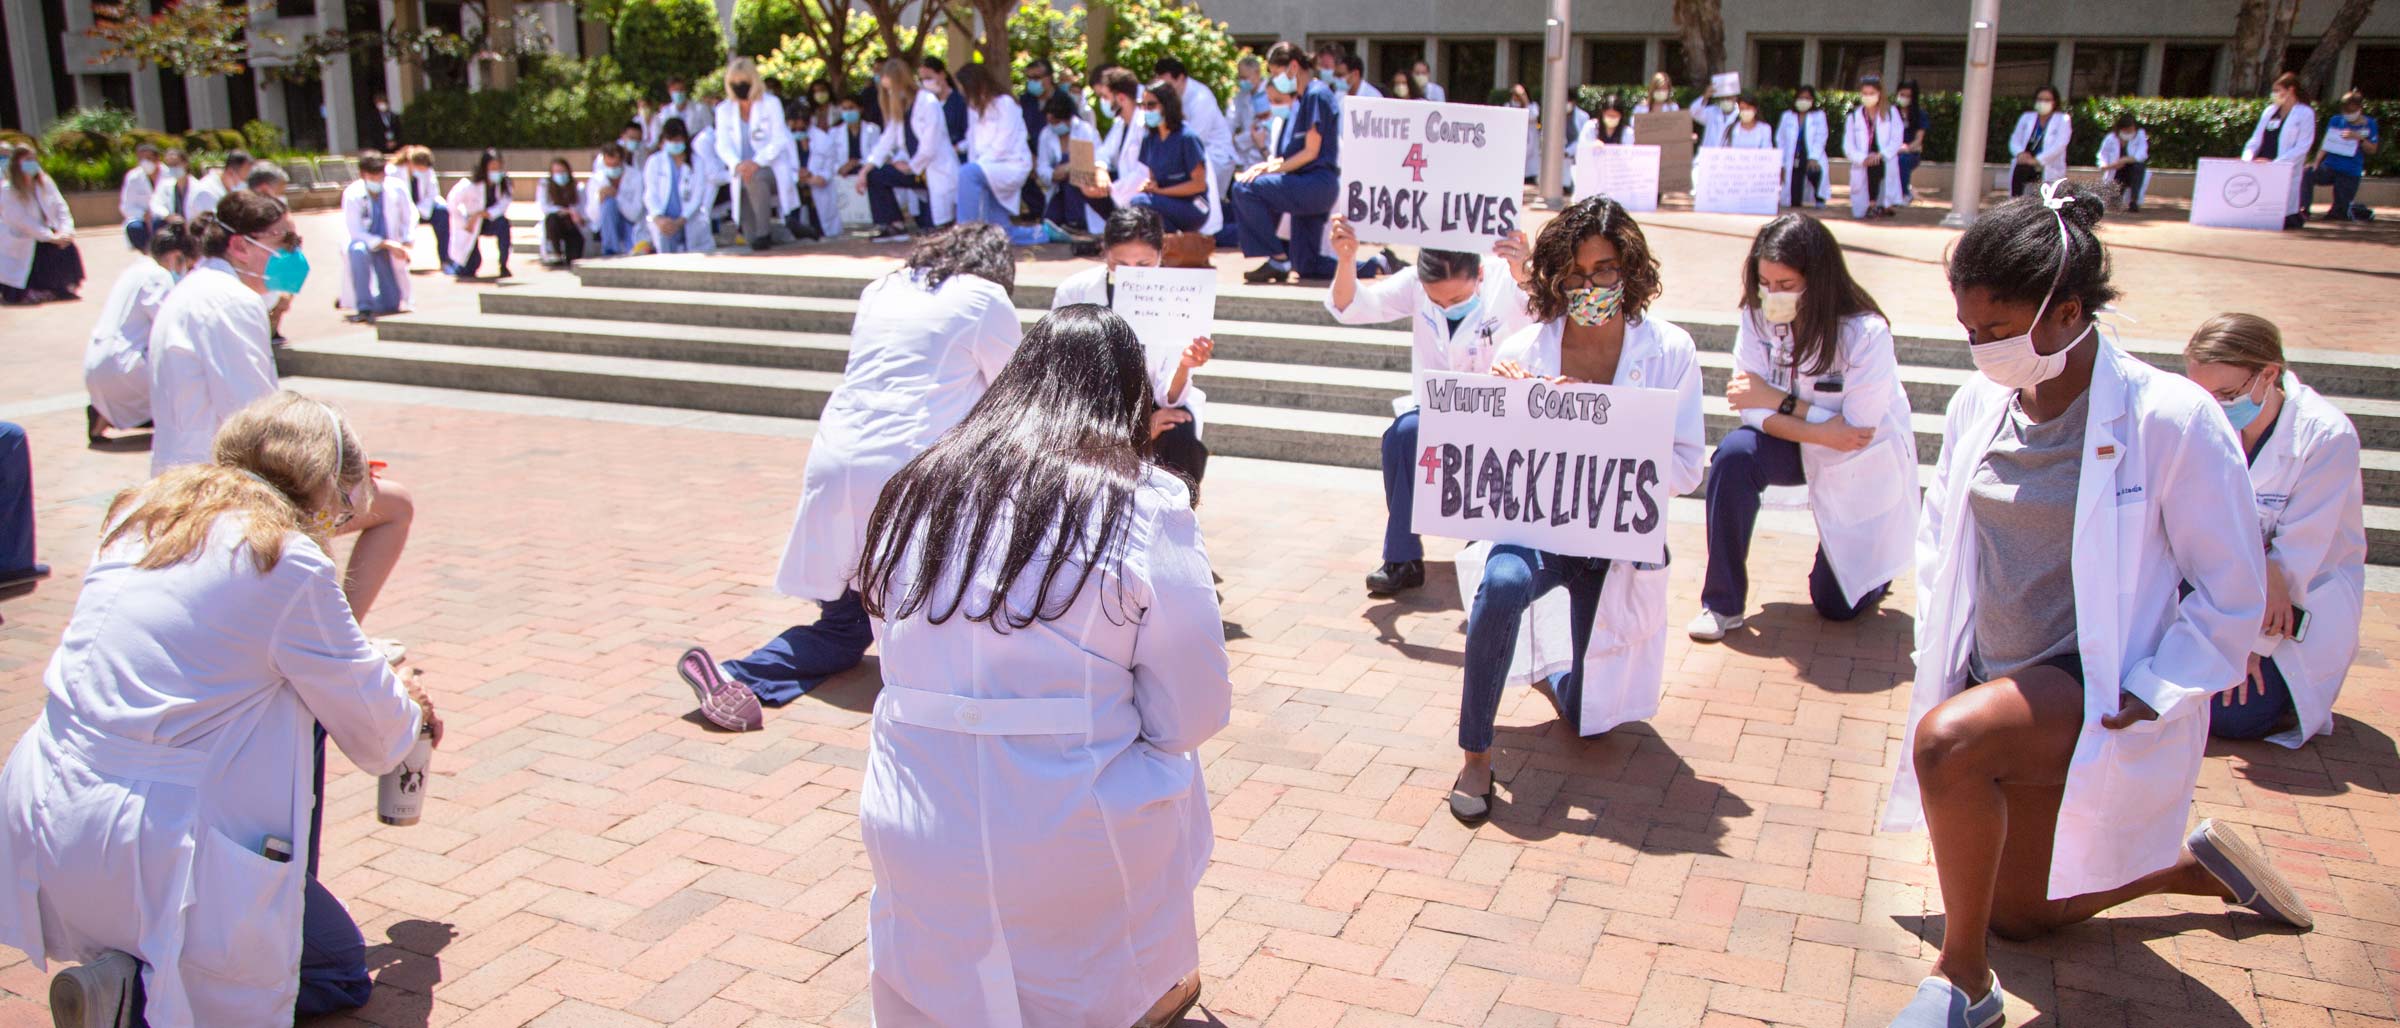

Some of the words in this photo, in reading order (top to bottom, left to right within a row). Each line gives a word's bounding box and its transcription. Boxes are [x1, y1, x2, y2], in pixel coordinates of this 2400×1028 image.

[1351, 110, 1410, 140] WHITE
[1425, 110, 1486, 148] COATS
[1402, 143, 1428, 182] 4
[1347, 180, 1430, 233] BLACK
[1441, 191, 1518, 237] LIVES
[1426, 379, 1507, 417] WHITE
[1527, 382, 1612, 425] COATS
[1418, 445, 1442, 485] 4
[1440, 443, 1551, 523] BLACK
[1550, 452, 1660, 535] LIVES
